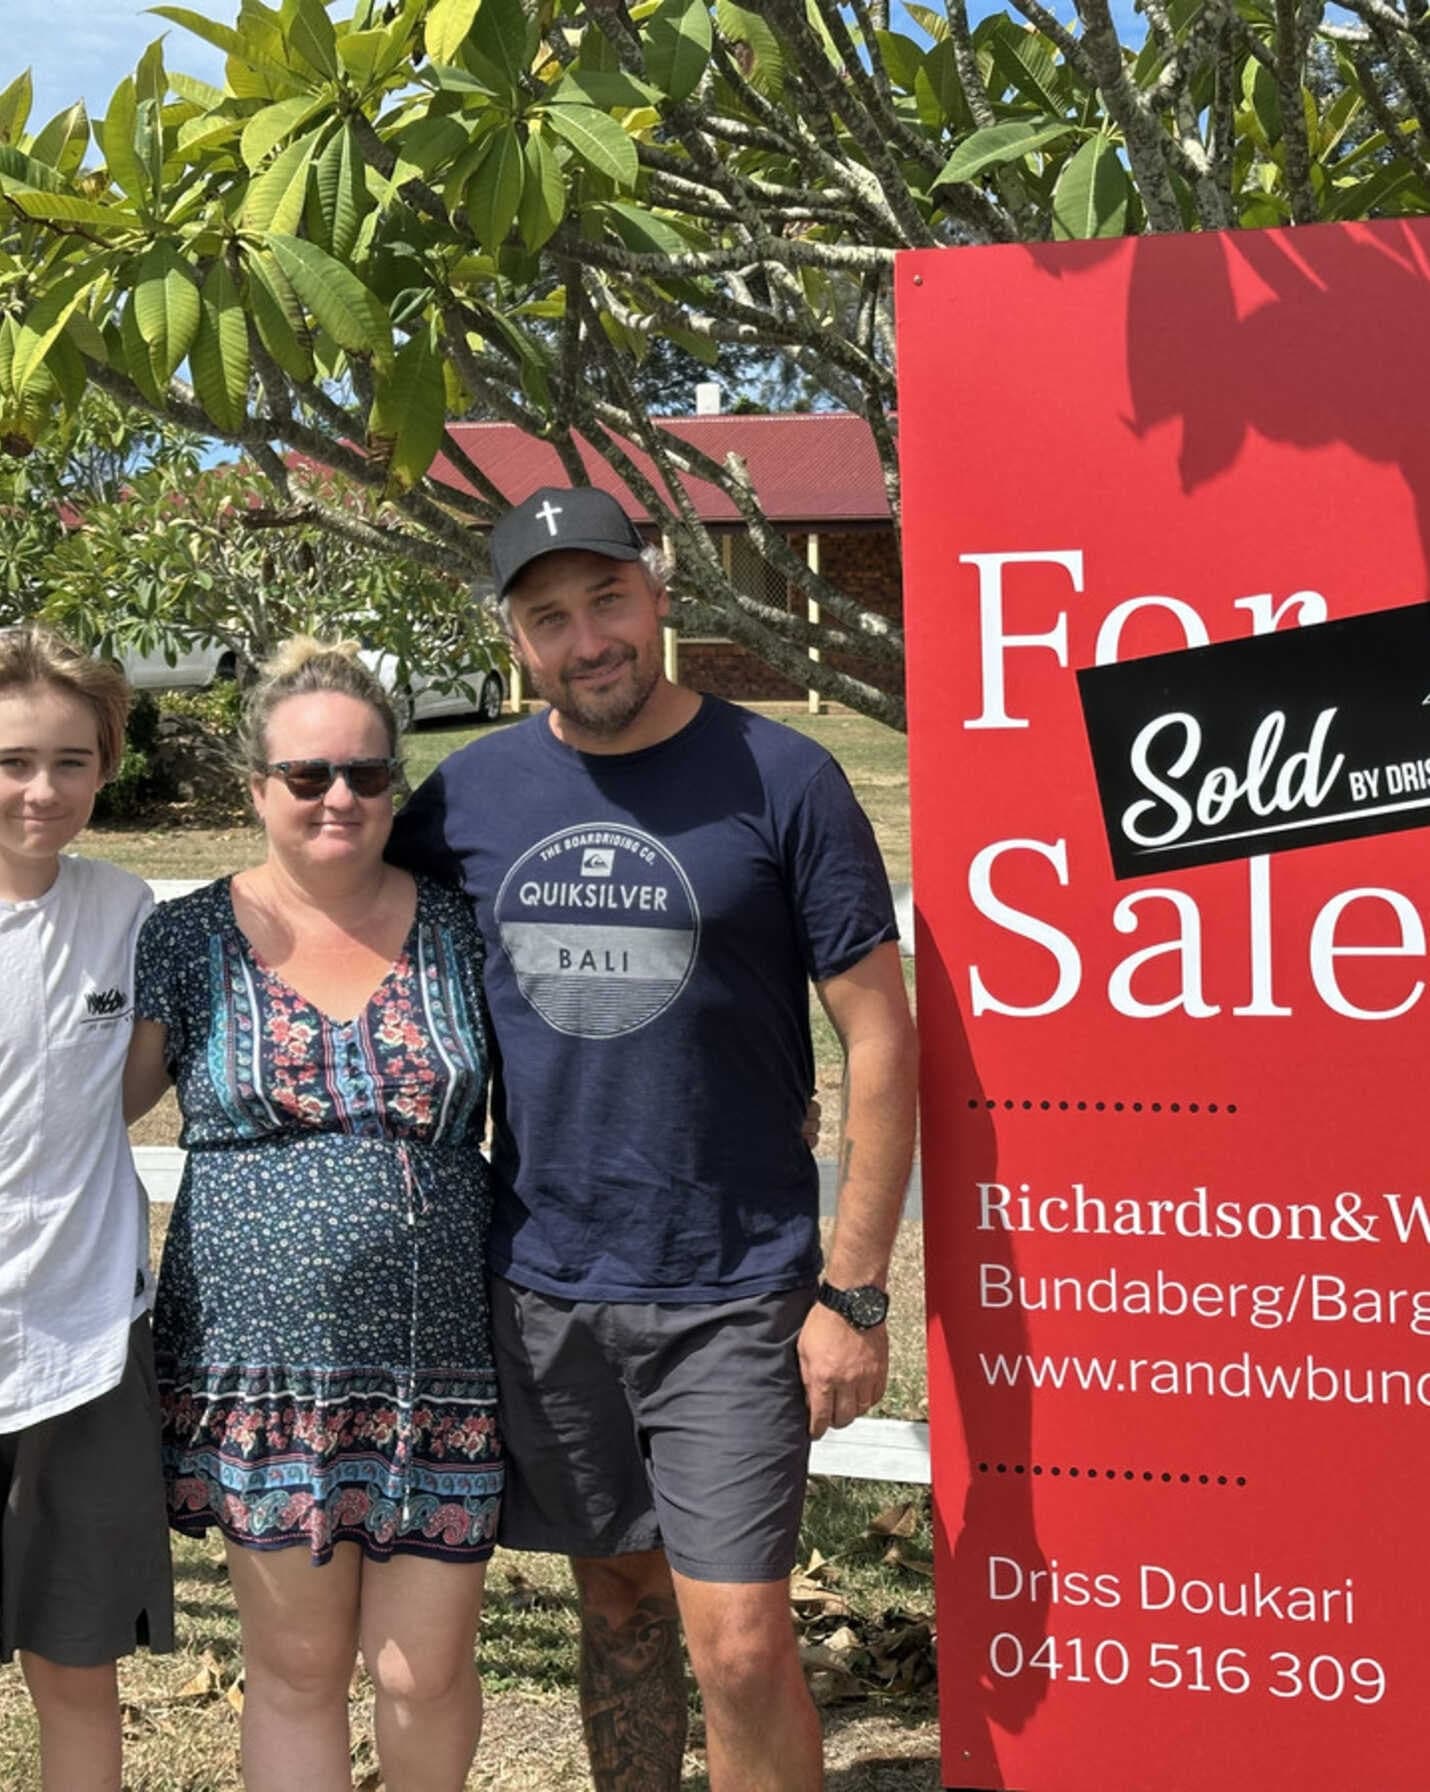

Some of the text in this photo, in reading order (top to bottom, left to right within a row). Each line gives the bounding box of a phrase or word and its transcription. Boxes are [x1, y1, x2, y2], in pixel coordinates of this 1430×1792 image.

[1121, 707, 1345, 847] Sold
[1348, 768, 1379, 802] BY
[540, 843, 563, 862] THE
[519, 881, 668, 912] QUIKSILVER
[968, 838, 1427, 1020] Sale
[559, 948, 628, 972] BALI
[988, 1556, 1354, 1624] Driss Doukari
[990, 1632, 1386, 1705] 0410 516 309
